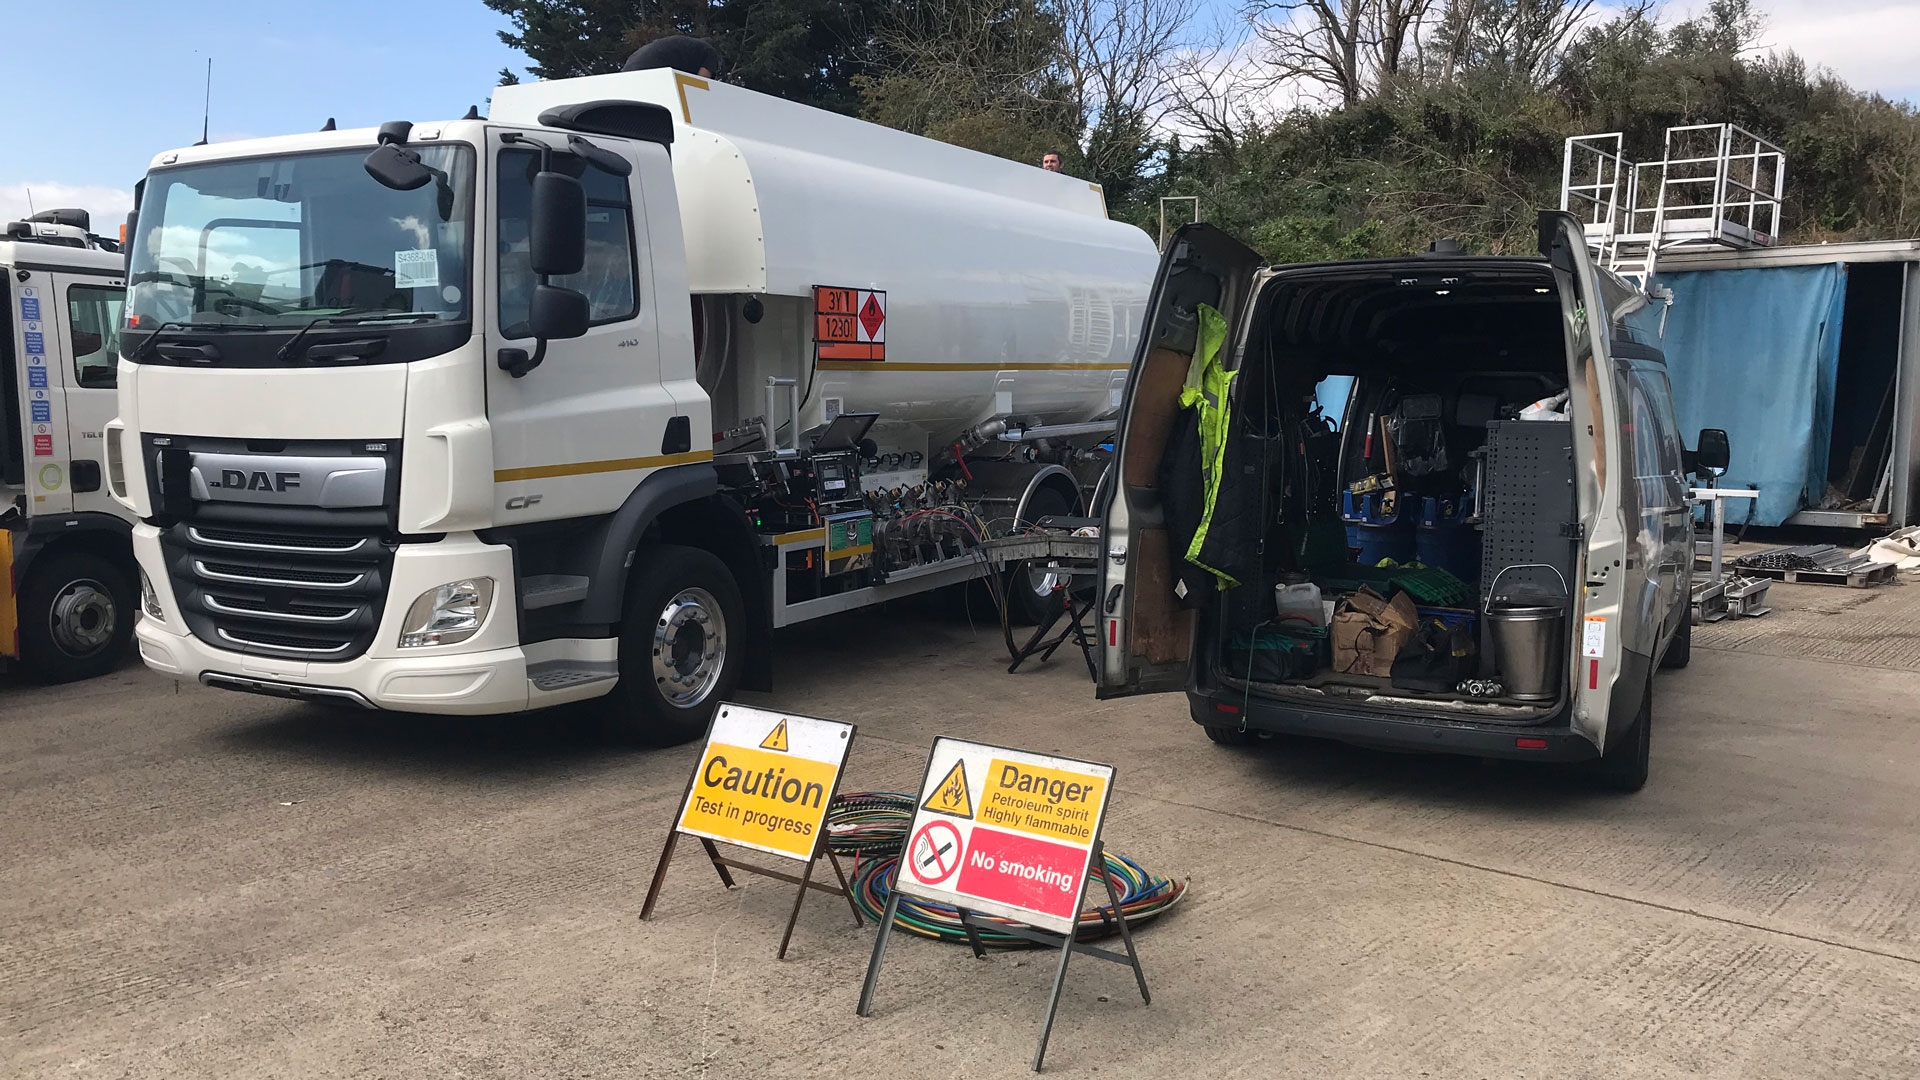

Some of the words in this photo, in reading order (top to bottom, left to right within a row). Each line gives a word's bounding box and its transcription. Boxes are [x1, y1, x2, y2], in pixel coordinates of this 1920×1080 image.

[222, 469, 301, 492] DAF
[505, 494, 543, 510] CF
[704, 755, 824, 808] Caution
[999, 764, 1093, 804] Danger
[695, 796, 724, 816] Test
[725, 802, 740, 819] in
[742, 810, 813, 836] progress
[983, 806, 1022, 828] Highly
[1024, 815, 1090, 839] flammable
[1056, 806, 1090, 822] spirit
[970, 850, 995, 870] No
